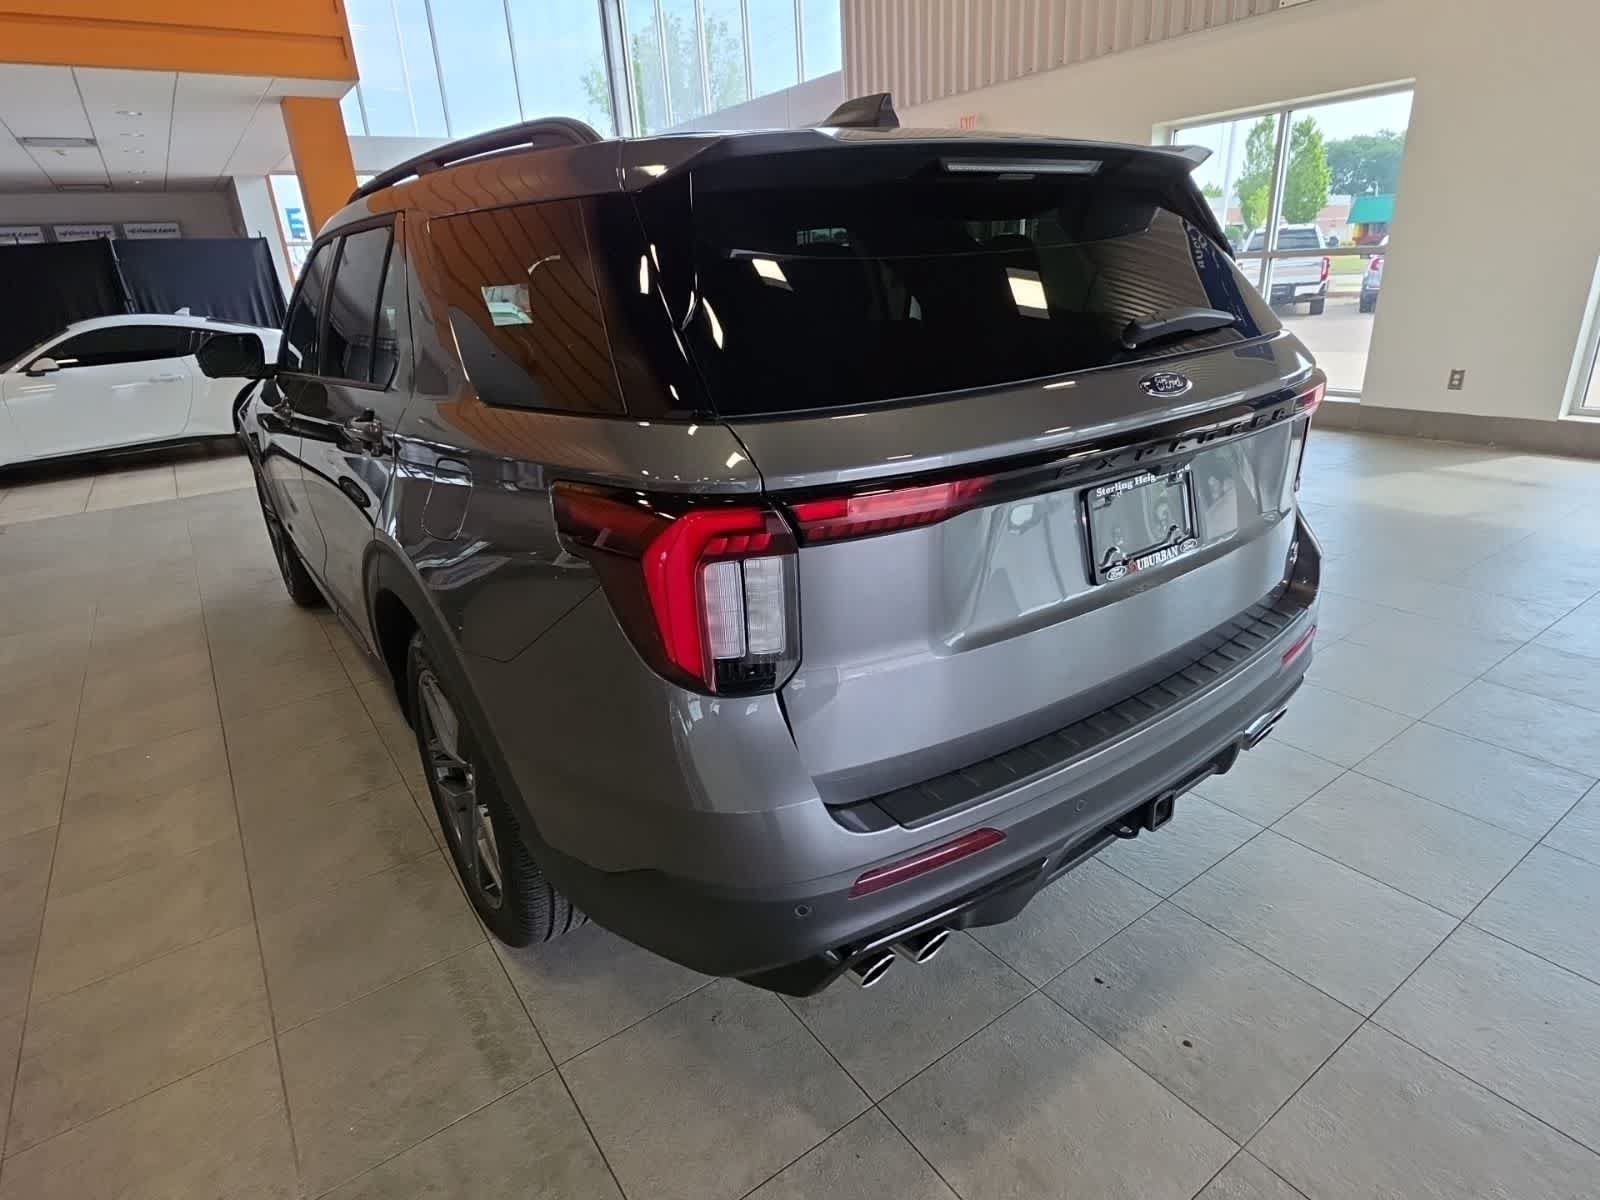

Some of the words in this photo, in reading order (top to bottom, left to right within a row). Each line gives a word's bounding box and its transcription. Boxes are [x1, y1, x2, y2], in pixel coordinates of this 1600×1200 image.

[1147, 373, 1186, 394] Ford
[1096, 480, 1133, 497] Sterling
[1128, 545, 1178, 571] SUBURBAN
